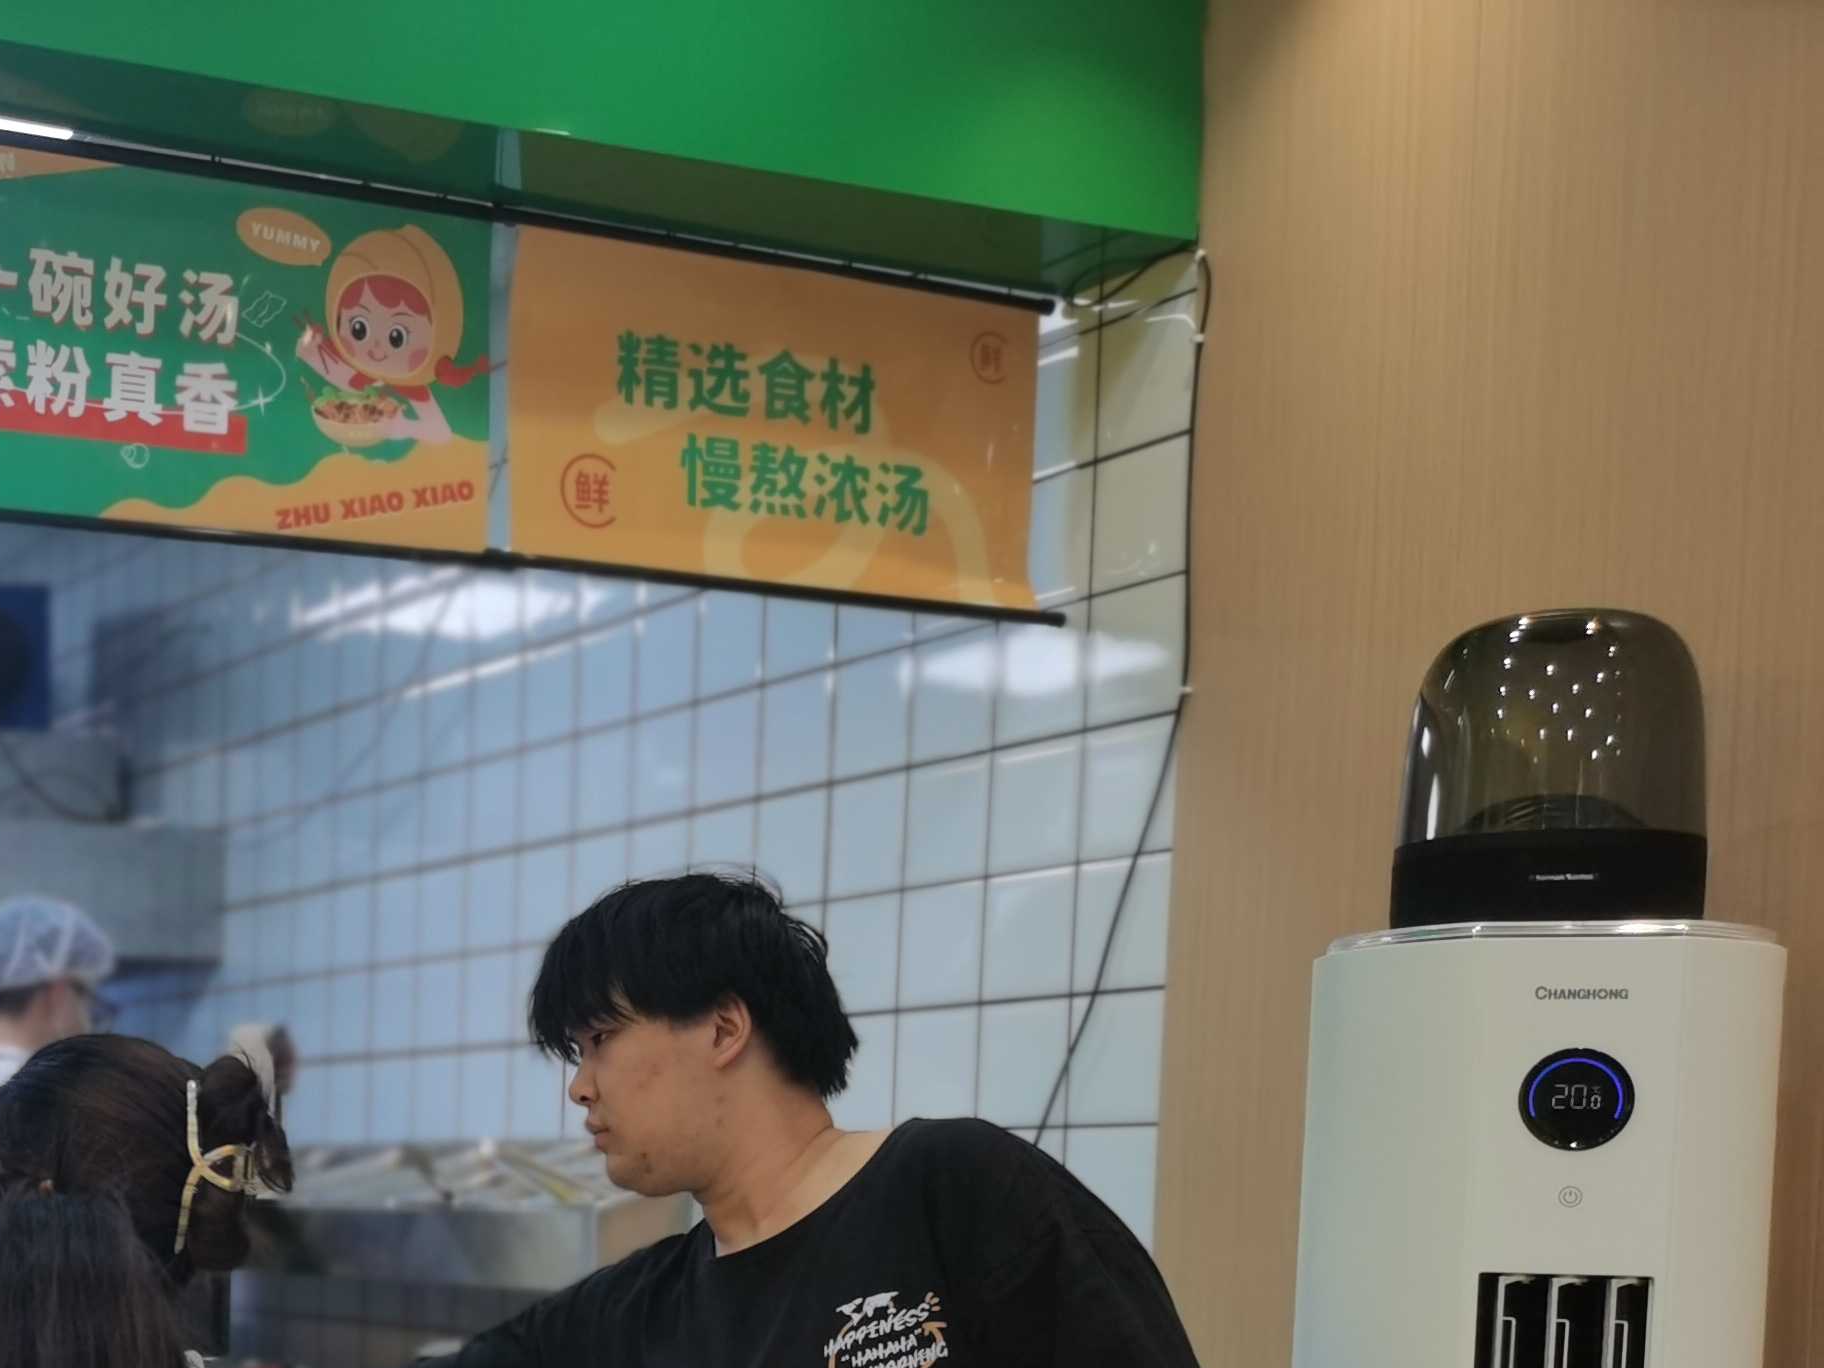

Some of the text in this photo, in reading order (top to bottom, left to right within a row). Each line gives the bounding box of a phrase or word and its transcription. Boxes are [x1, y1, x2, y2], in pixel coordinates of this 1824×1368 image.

[249, 220, 322, 254] YUMMY
[616, 329, 876, 436] 精选食材
[276, 480, 475, 531] ZHU XIAO XIAO
[678, 432, 931, 538] 慢熬浓汤
[1535, 986, 1629, 1001] CHANGHONG
